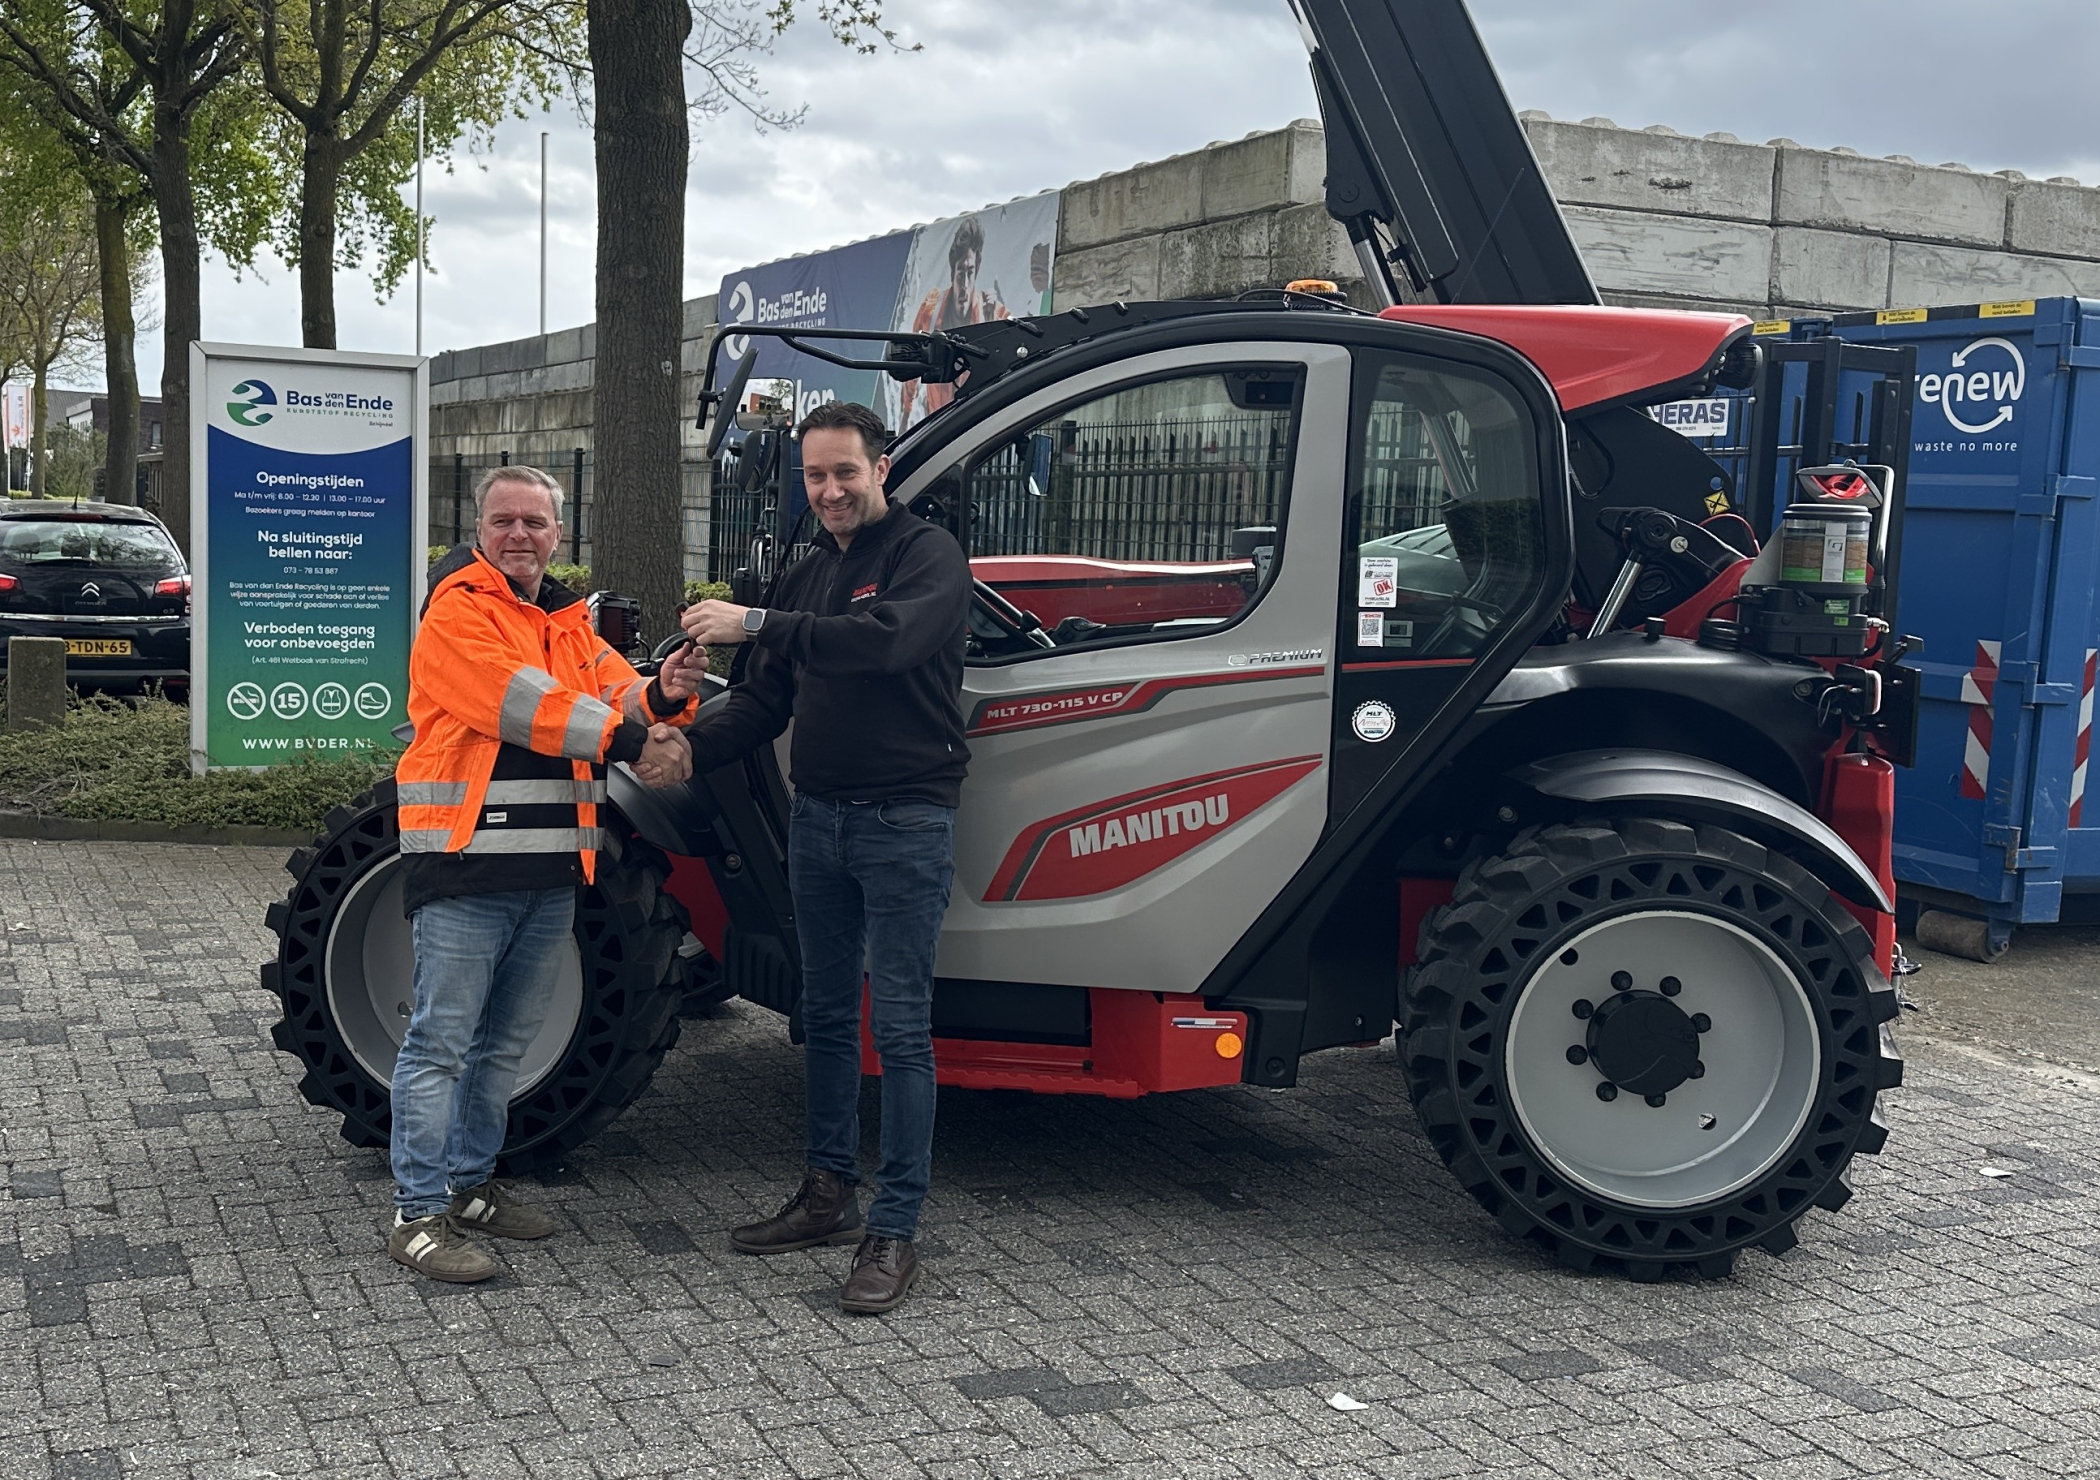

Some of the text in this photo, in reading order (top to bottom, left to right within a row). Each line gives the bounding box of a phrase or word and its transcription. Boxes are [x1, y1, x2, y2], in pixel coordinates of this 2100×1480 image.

[758, 286, 827, 323] Bas van den Ende
[1914, 371, 2020, 402] enew
[286, 390, 322, 407] Bas
[325, 400, 343, 408] den
[346, 394, 393, 411] Ende
[1654, 402, 1725, 425] HERAS
[1915, 441, 2017, 452] waste no more
[256, 471, 364, 489] Openingstijden
[248, 491, 262, 500] t/m
[258, 530, 363, 547] Na sluitingstijd
[269, 546, 353, 560] bellen naar:
[1377, 580, 1392, 594] OK
[244, 621, 375, 638] Verboden toegang
[244, 637, 375, 652] voor onbevoegden
[1249, 648, 1323, 664] PREMIUM
[278, 693, 300, 709] 15
[987, 692, 1123, 719] MLT 730-115 V CP
[1069, 793, 1229, 858] MANITOU
